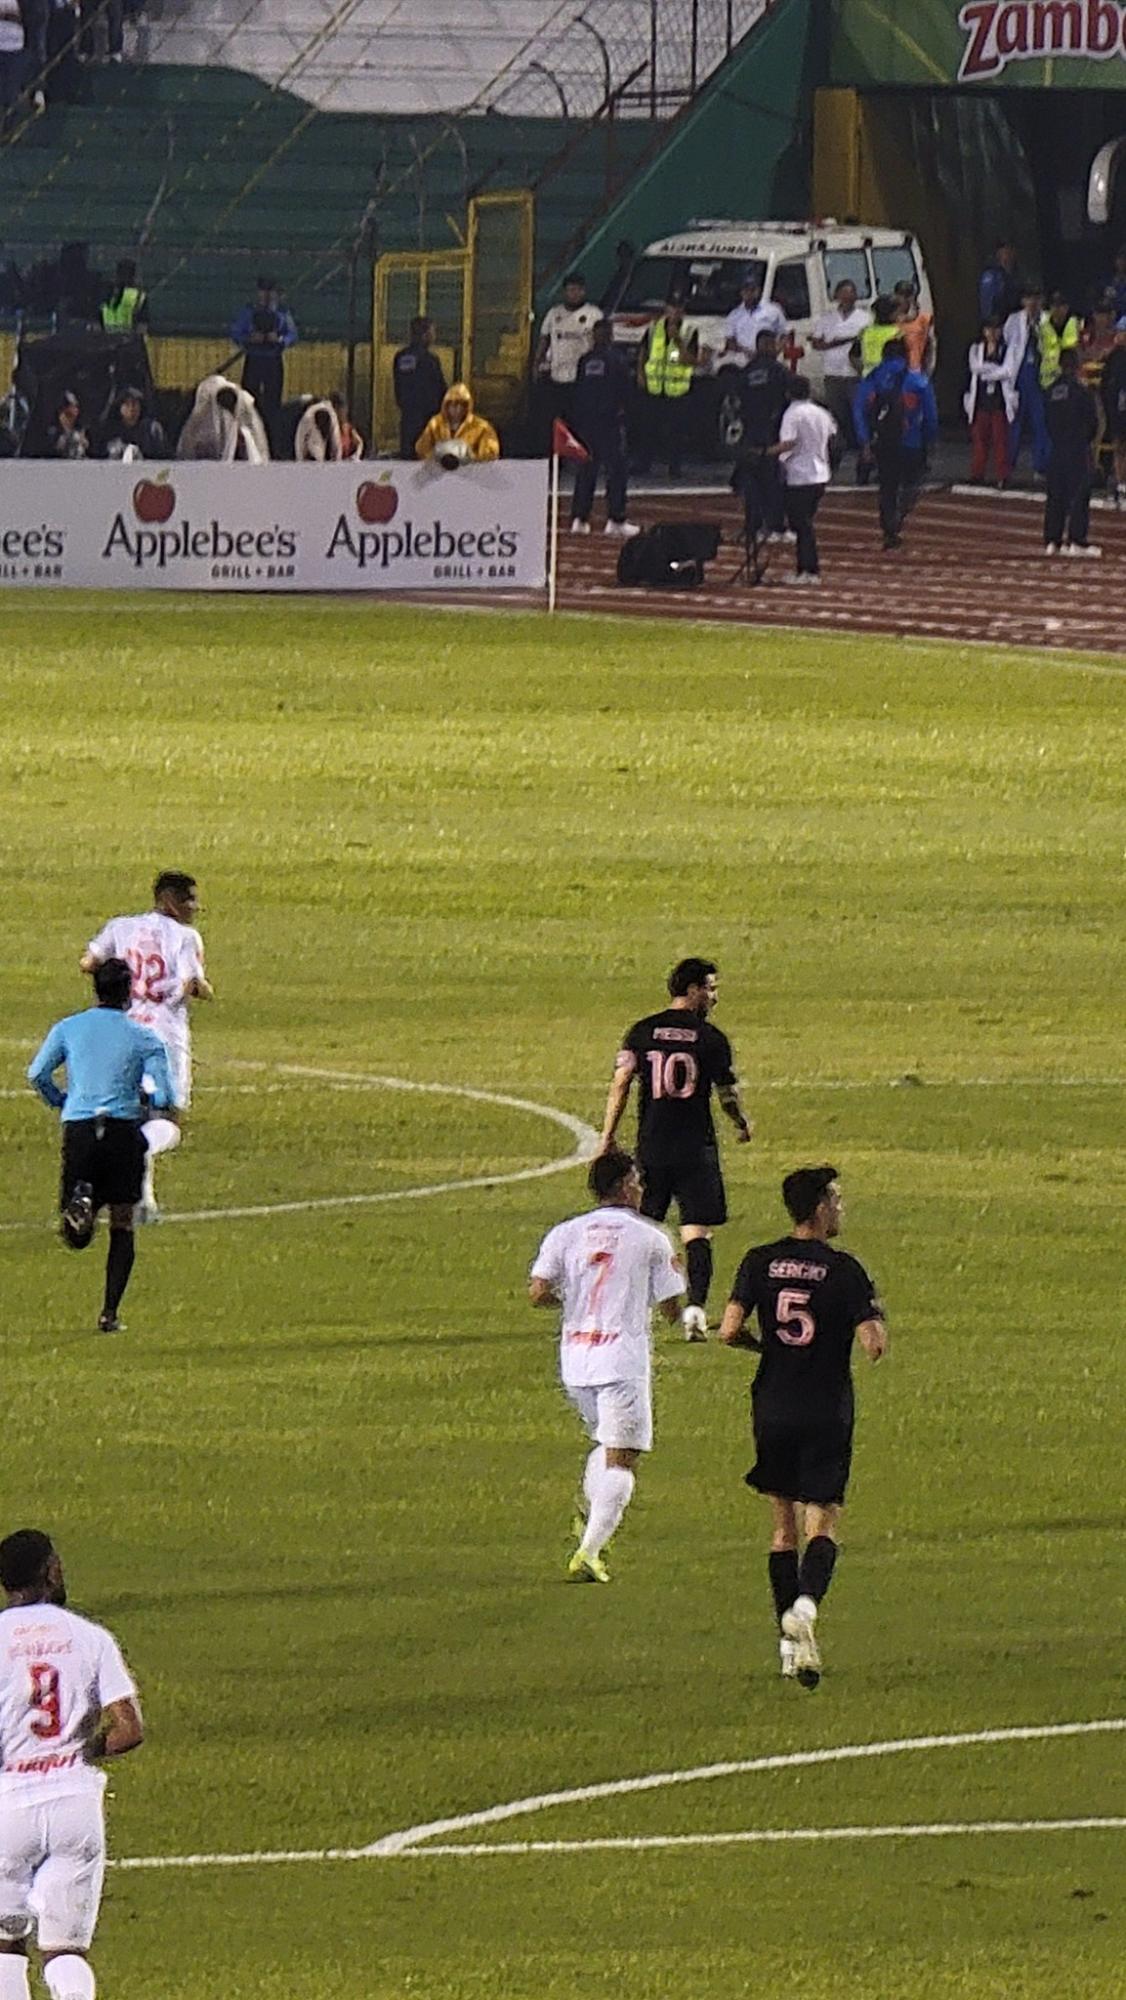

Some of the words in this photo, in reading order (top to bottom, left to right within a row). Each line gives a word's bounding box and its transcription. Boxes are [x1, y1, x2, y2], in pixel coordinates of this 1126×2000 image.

[961, 0, 1126, 80] Zamb
[102, 513, 297, 567] Applebee's
[326, 514, 518, 568] Applebee's
[34, 563, 62, 578] BAR
[211, 565, 250, 579] GRILL
[267, 564, 295, 578] BAR
[433, 565, 471, 579] GRILL
[488, 565, 516, 577] BAR
[645, 1050, 697, 1100] 10
[586, 1251, 614, 1315] 7
[768, 1258, 828, 1281] SERGIO
[776, 1287, 815, 1346] 5
[30, 1662, 61, 1739] 9
